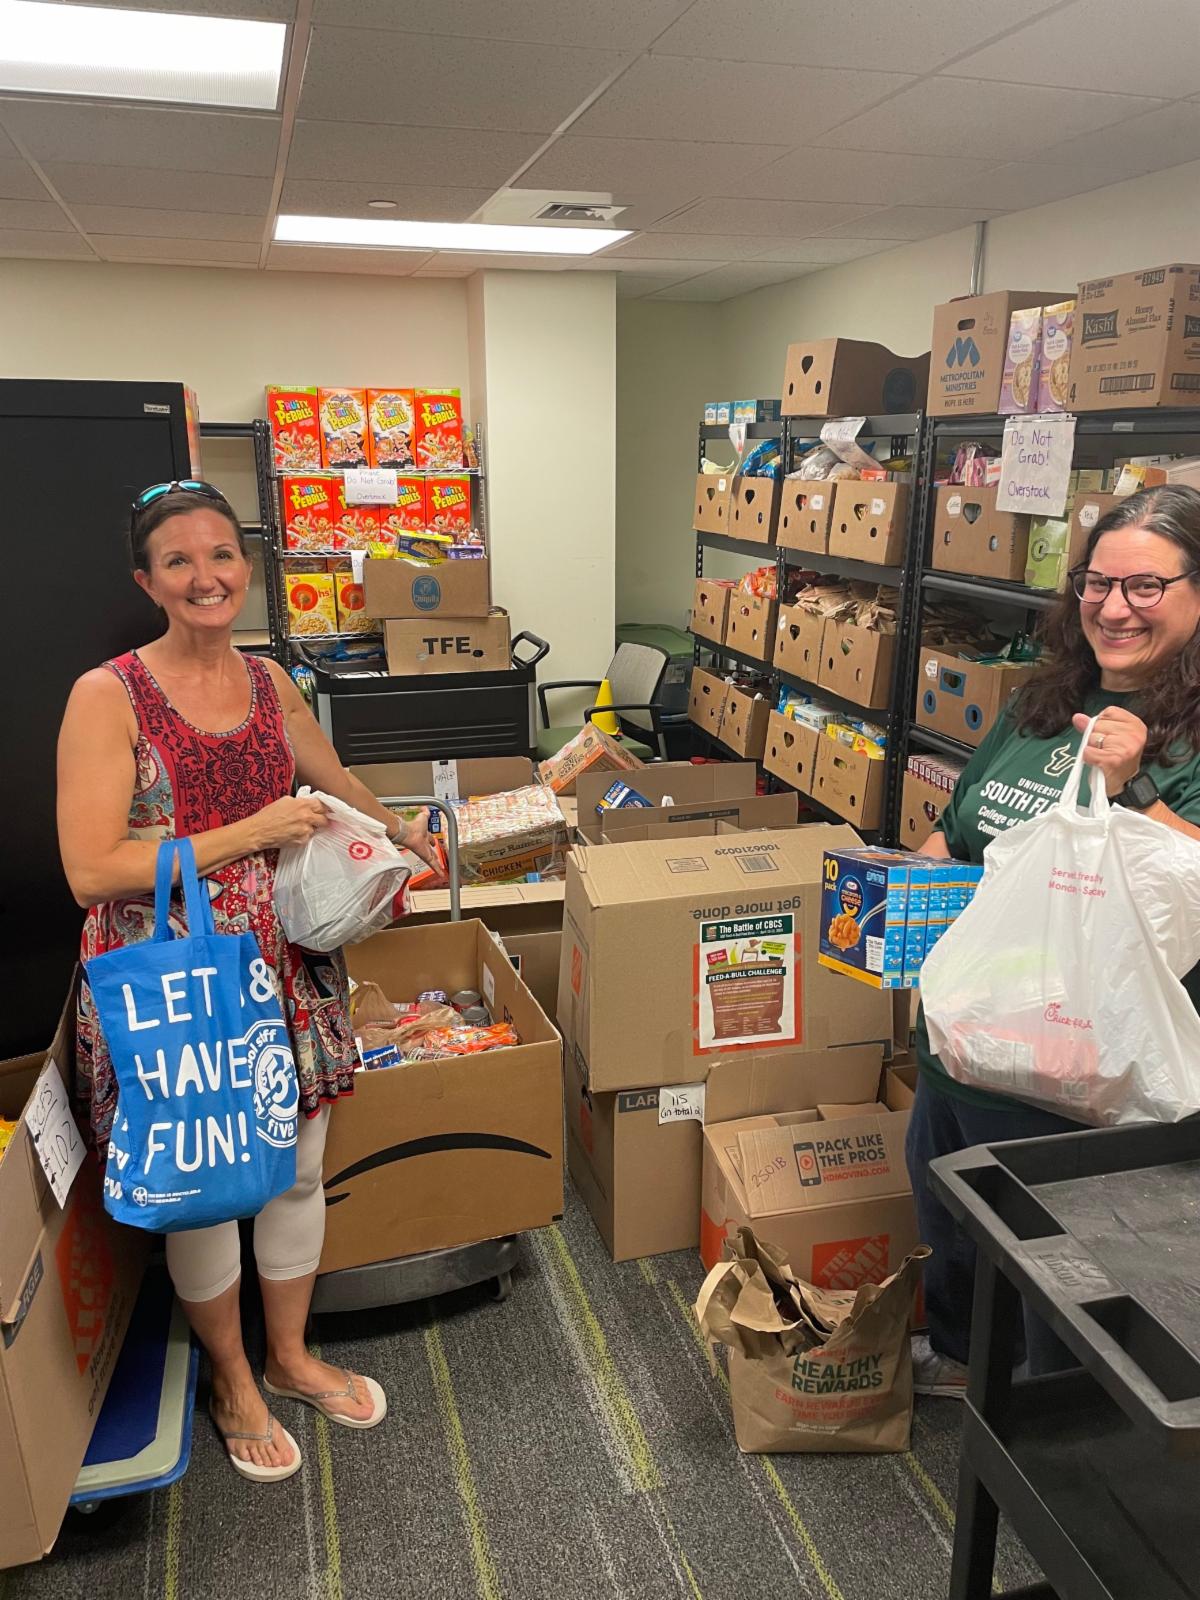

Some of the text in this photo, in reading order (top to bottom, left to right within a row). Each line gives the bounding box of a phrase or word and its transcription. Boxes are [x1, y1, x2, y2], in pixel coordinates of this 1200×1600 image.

[1086, 317, 1114, 334] Kashi
[940, 370, 984, 382] METROPOLITAN
[945, 382, 976, 392] MINISTRIES
[963, 398, 974, 406] HERE
[275, 408, 313, 426] PEBBLES
[422, 410, 456, 427] PEBBLES
[1012, 430, 1052, 446] Do Not
[1018, 450, 1049, 466] Grab!
[1008, 481, 1050, 499] Overstock
[396, 492, 420, 508] EBBLES
[980, 780, 1034, 812] SOUTH
[1018, 778, 1062, 798] UNIVERSIT
[978, 806, 1018, 827] College of
[488, 848, 506, 858] Top
[482, 861, 522, 878] CHICKEN
[824, 859, 838, 881] 10
[825, 882, 837, 891] pack
[734, 902, 773, 916] more
[777, 896, 801, 914] get
[720, 926, 731, 934] The
[733, 923, 753, 932] Battle
[764, 920, 782, 929] CBCS
[250, 958, 276, 1003] &
[708, 968, 782, 982] FEED-A-BULL CHALLENGE
[134, 1038, 252, 1100] HAVE
[626, 1094, 660, 1109] LAR
[660, 1107, 672, 1118] (in
[675, 1106, 693, 1116] total
[267, 1119, 294, 1139] five
[50, 1120, 78, 1176] 102
[144, 1112, 250, 1175] FUN!
[817, 1134, 884, 1153] PACK LIKE
[820, 1154, 846, 1168] THE
[848, 1148, 886, 1164] PROS
[823, 1167, 890, 1182] HDMOVING.COM
[794, 1353, 882, 1379] HEALTHY
[792, 1371, 883, 1394] REWARDS
